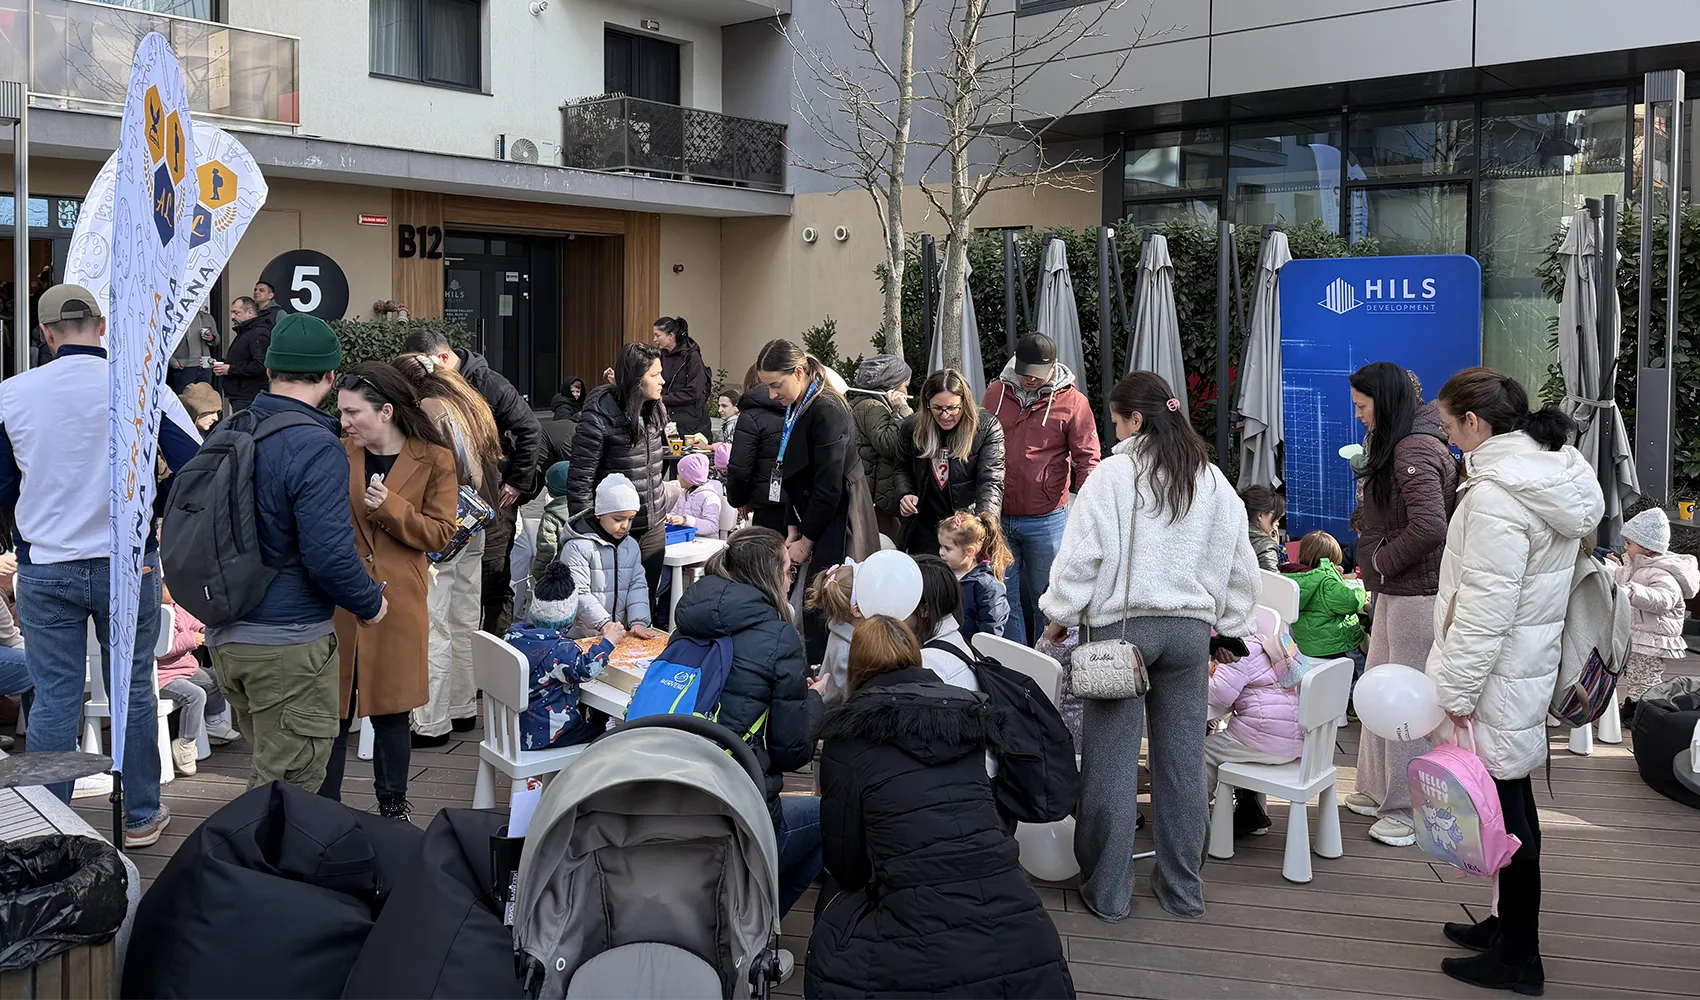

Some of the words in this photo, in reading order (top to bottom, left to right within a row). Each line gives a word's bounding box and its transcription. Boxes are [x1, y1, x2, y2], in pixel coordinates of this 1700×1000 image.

[398, 224, 443, 258] B12
[171, 266, 215, 334] JANA
[290, 265, 322, 313] 5
[444, 291, 465, 299] HILS
[1365, 278, 1436, 299] HILS
[131, 485, 146, 576] ANA
[143, 277, 178, 466] LUGOJANA
[1418, 770, 1448, 793] HELLO
[1420, 782, 1449, 804] KITTY
